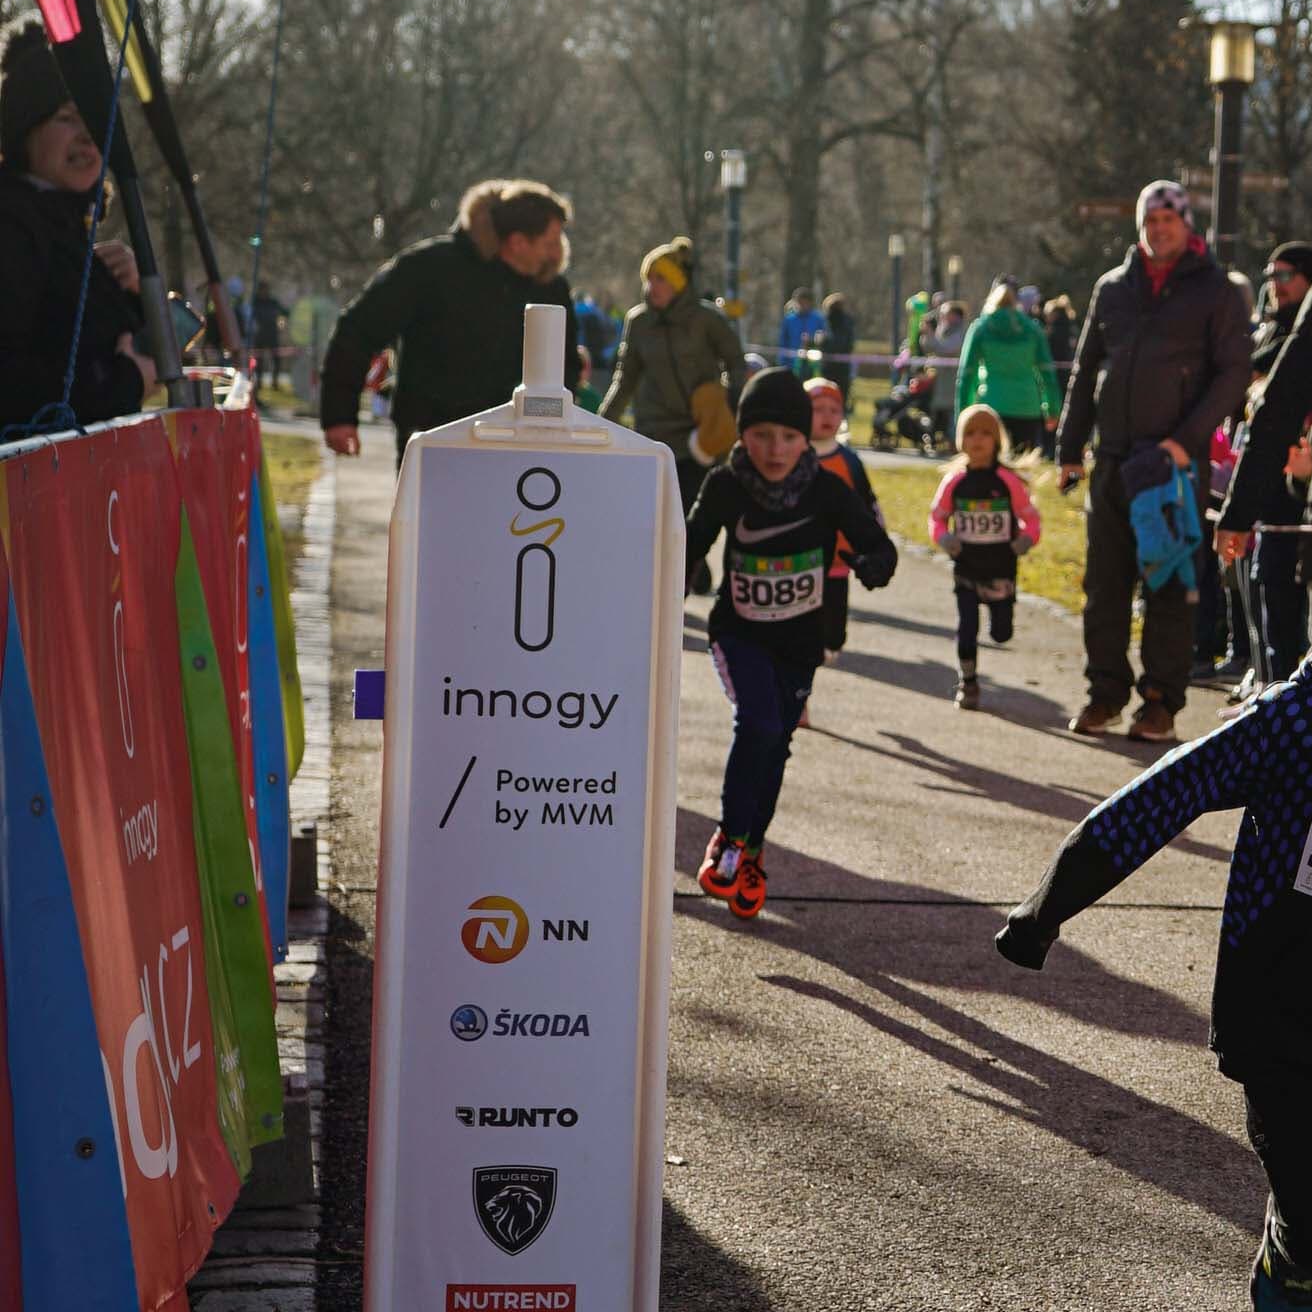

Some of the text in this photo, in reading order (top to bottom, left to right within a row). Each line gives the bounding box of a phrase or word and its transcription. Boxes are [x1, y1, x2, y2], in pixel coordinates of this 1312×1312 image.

[734, 574, 815, 606] 3089
[442, 677, 619, 729] innogy
[496, 770, 617, 794] Powered
[495, 800, 614, 831] by MVM
[541, 919, 590, 942] NN
[493, 1009, 590, 1037] ŠKODA
[479, 1107, 579, 1128] RUNTO
[480, 1173, 550, 1183] PEUGEOT
[454, 1291, 570, 1310] NUTREND
